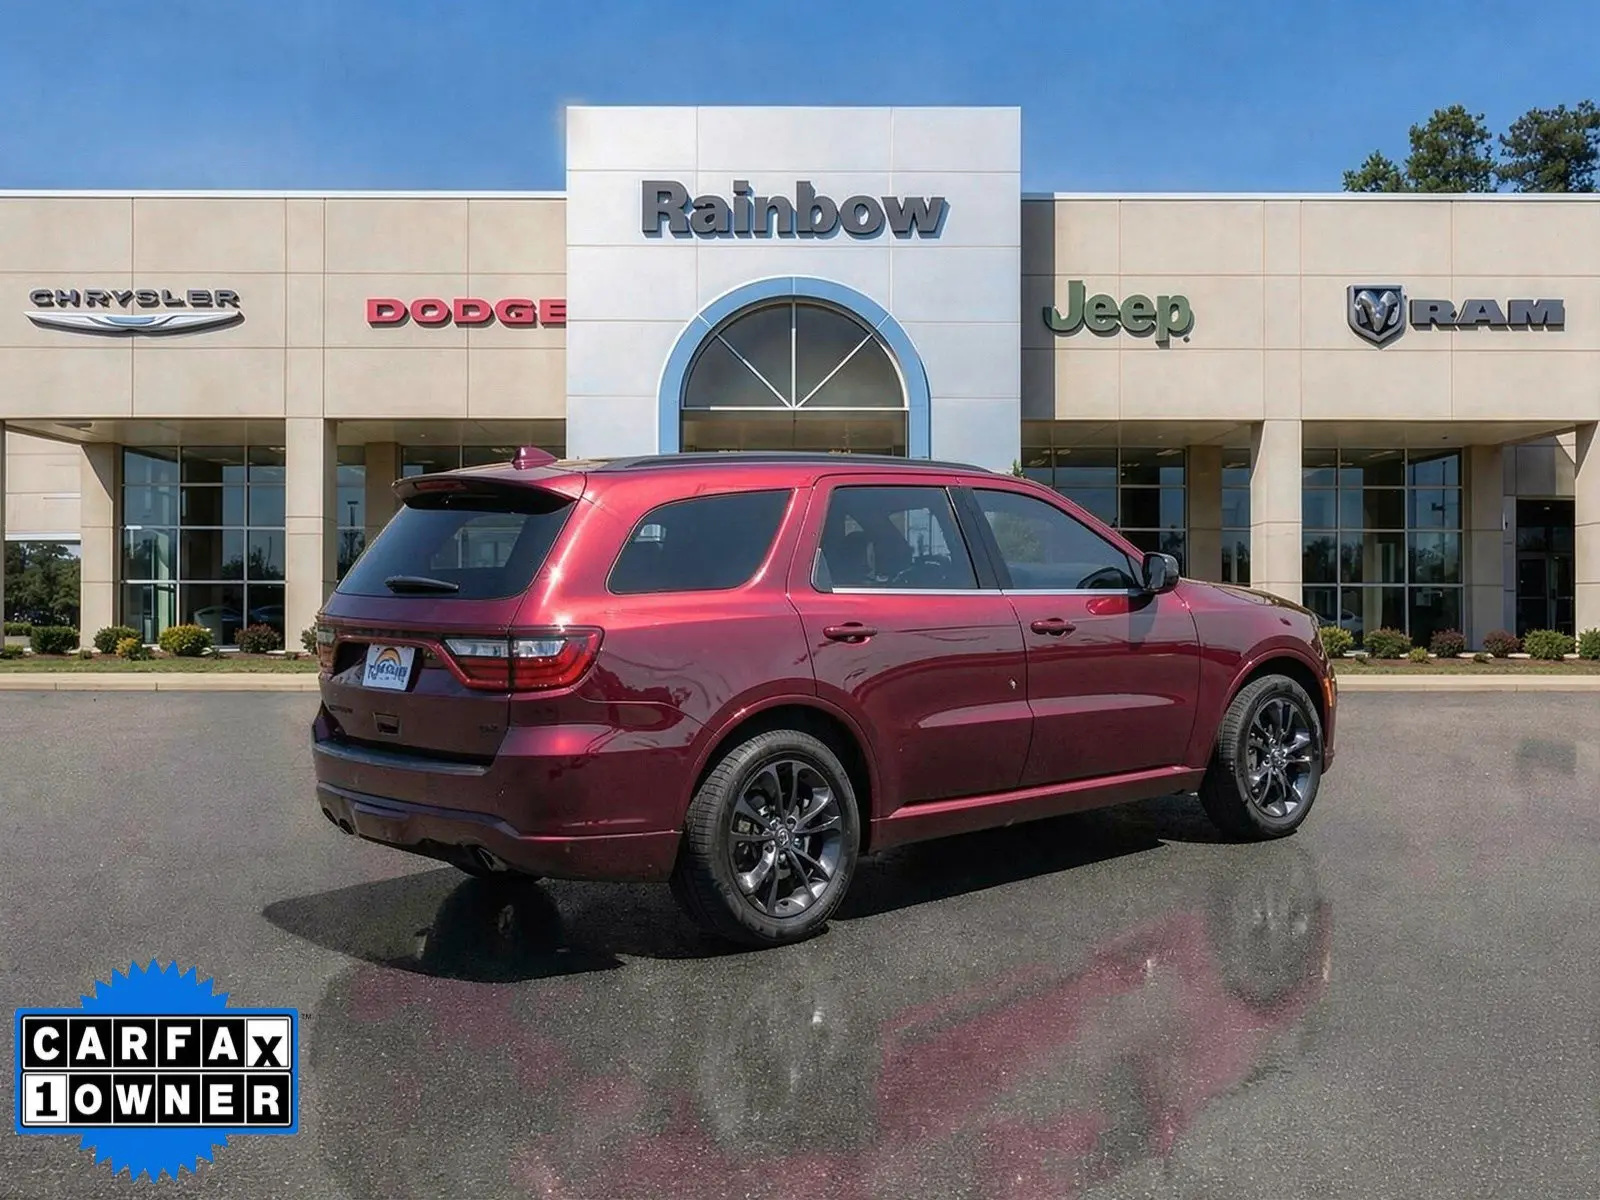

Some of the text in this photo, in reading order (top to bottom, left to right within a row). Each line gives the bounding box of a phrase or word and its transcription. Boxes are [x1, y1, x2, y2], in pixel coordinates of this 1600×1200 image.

[642, 179, 948, 238] Rainbow
[29, 289, 241, 308] CHRYSLER
[1043, 280, 1193, 347] Jeep
[1409, 299, 1565, 330] RAM
